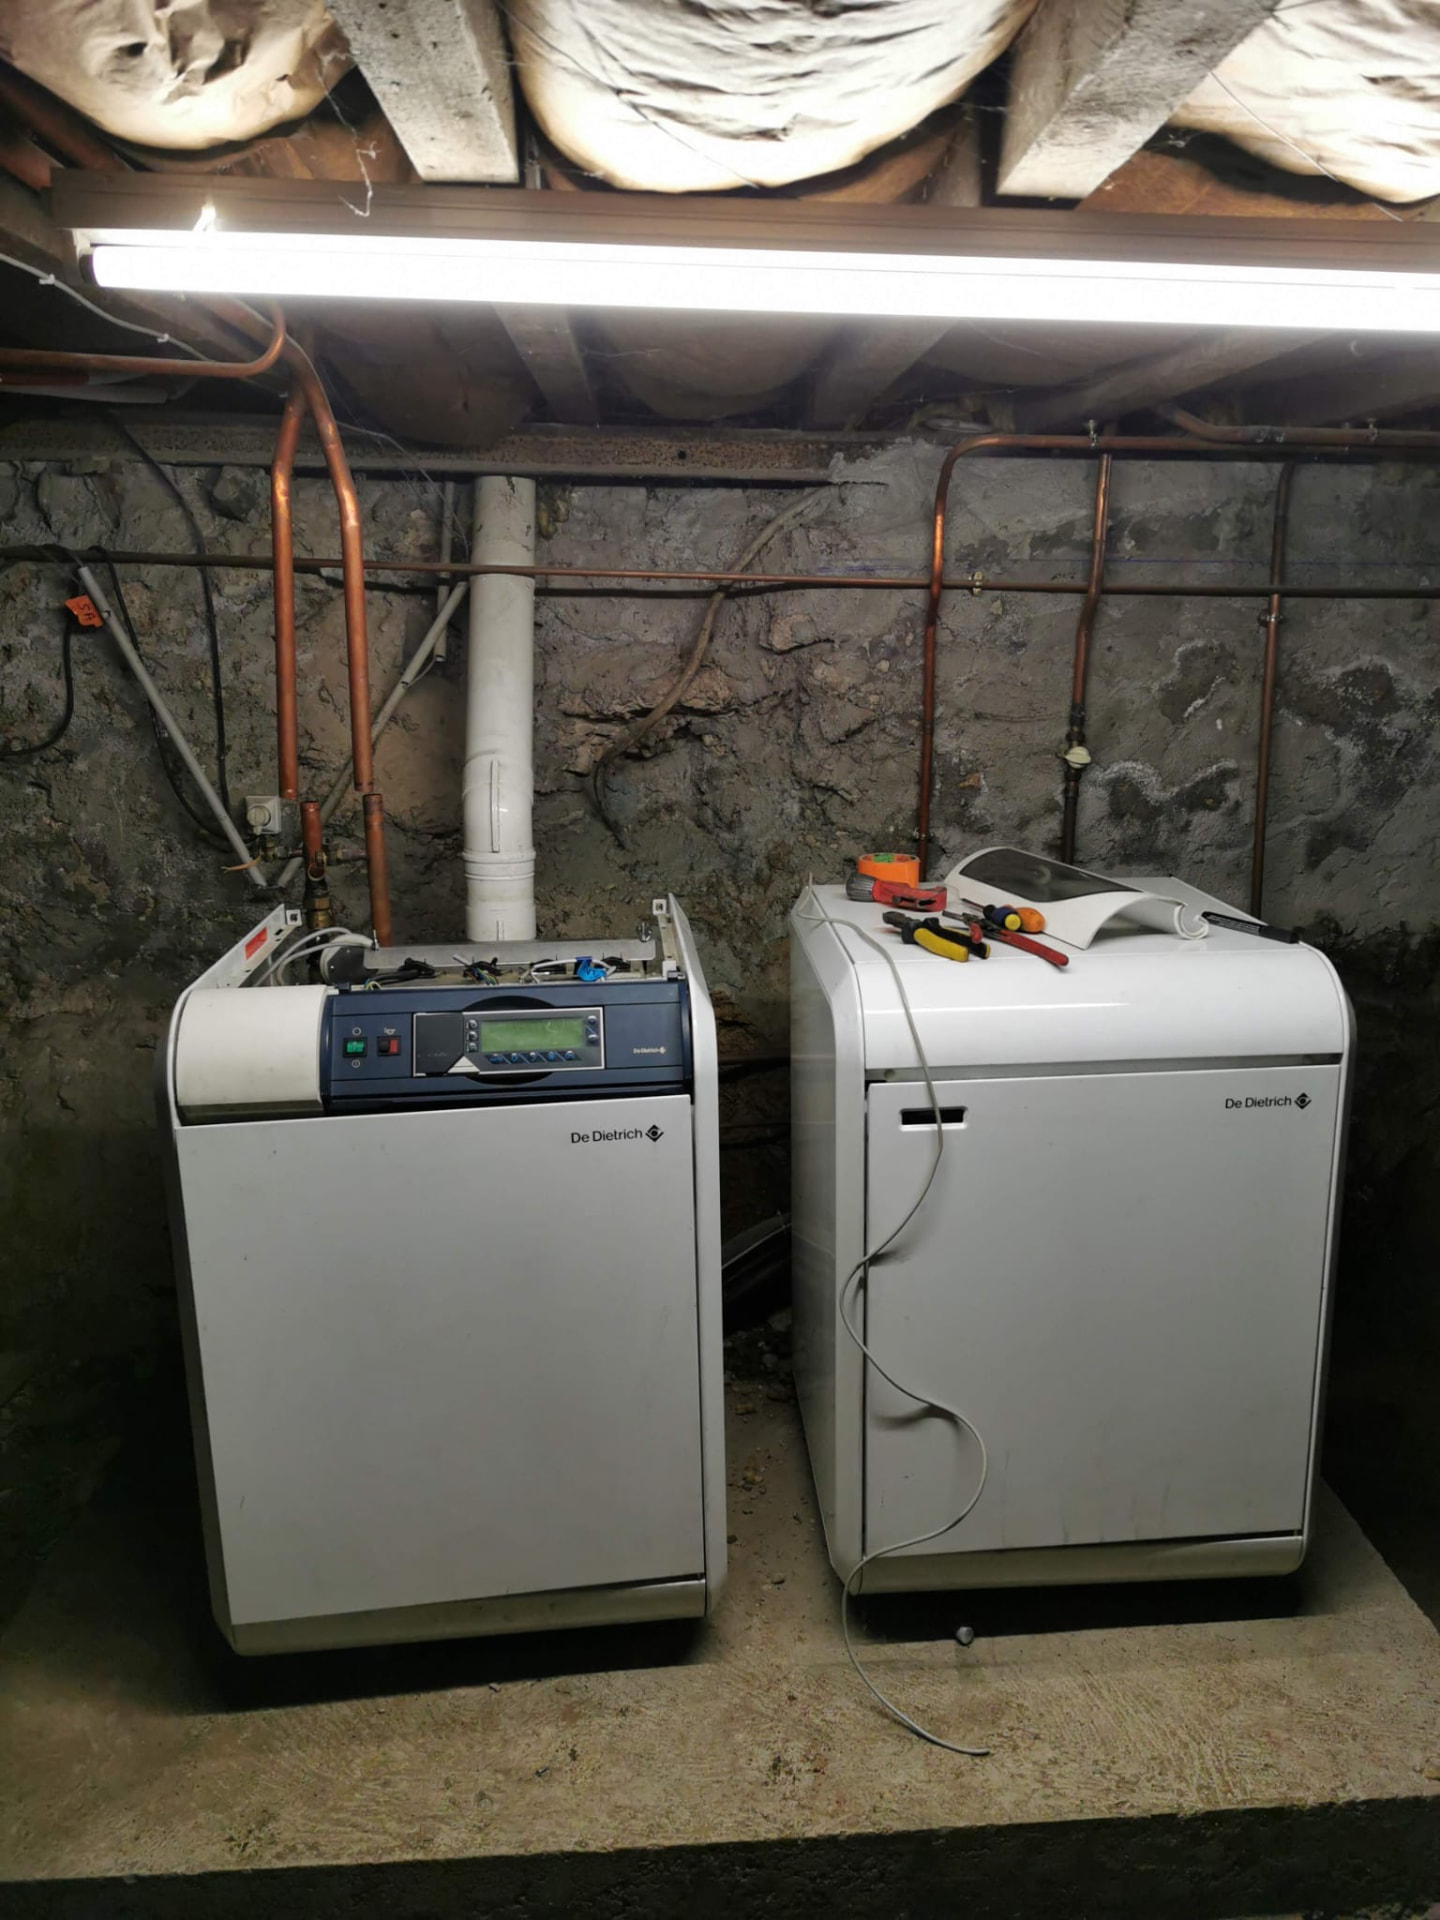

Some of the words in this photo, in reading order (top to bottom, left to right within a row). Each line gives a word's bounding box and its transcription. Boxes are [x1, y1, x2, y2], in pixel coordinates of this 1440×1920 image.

[1225, 1098, 1242, 1109] De
[1245, 1096, 1292, 1108] Dietrich
[571, 1132, 590, 1144] De
[592, 1128, 643, 1142] Dietrich
